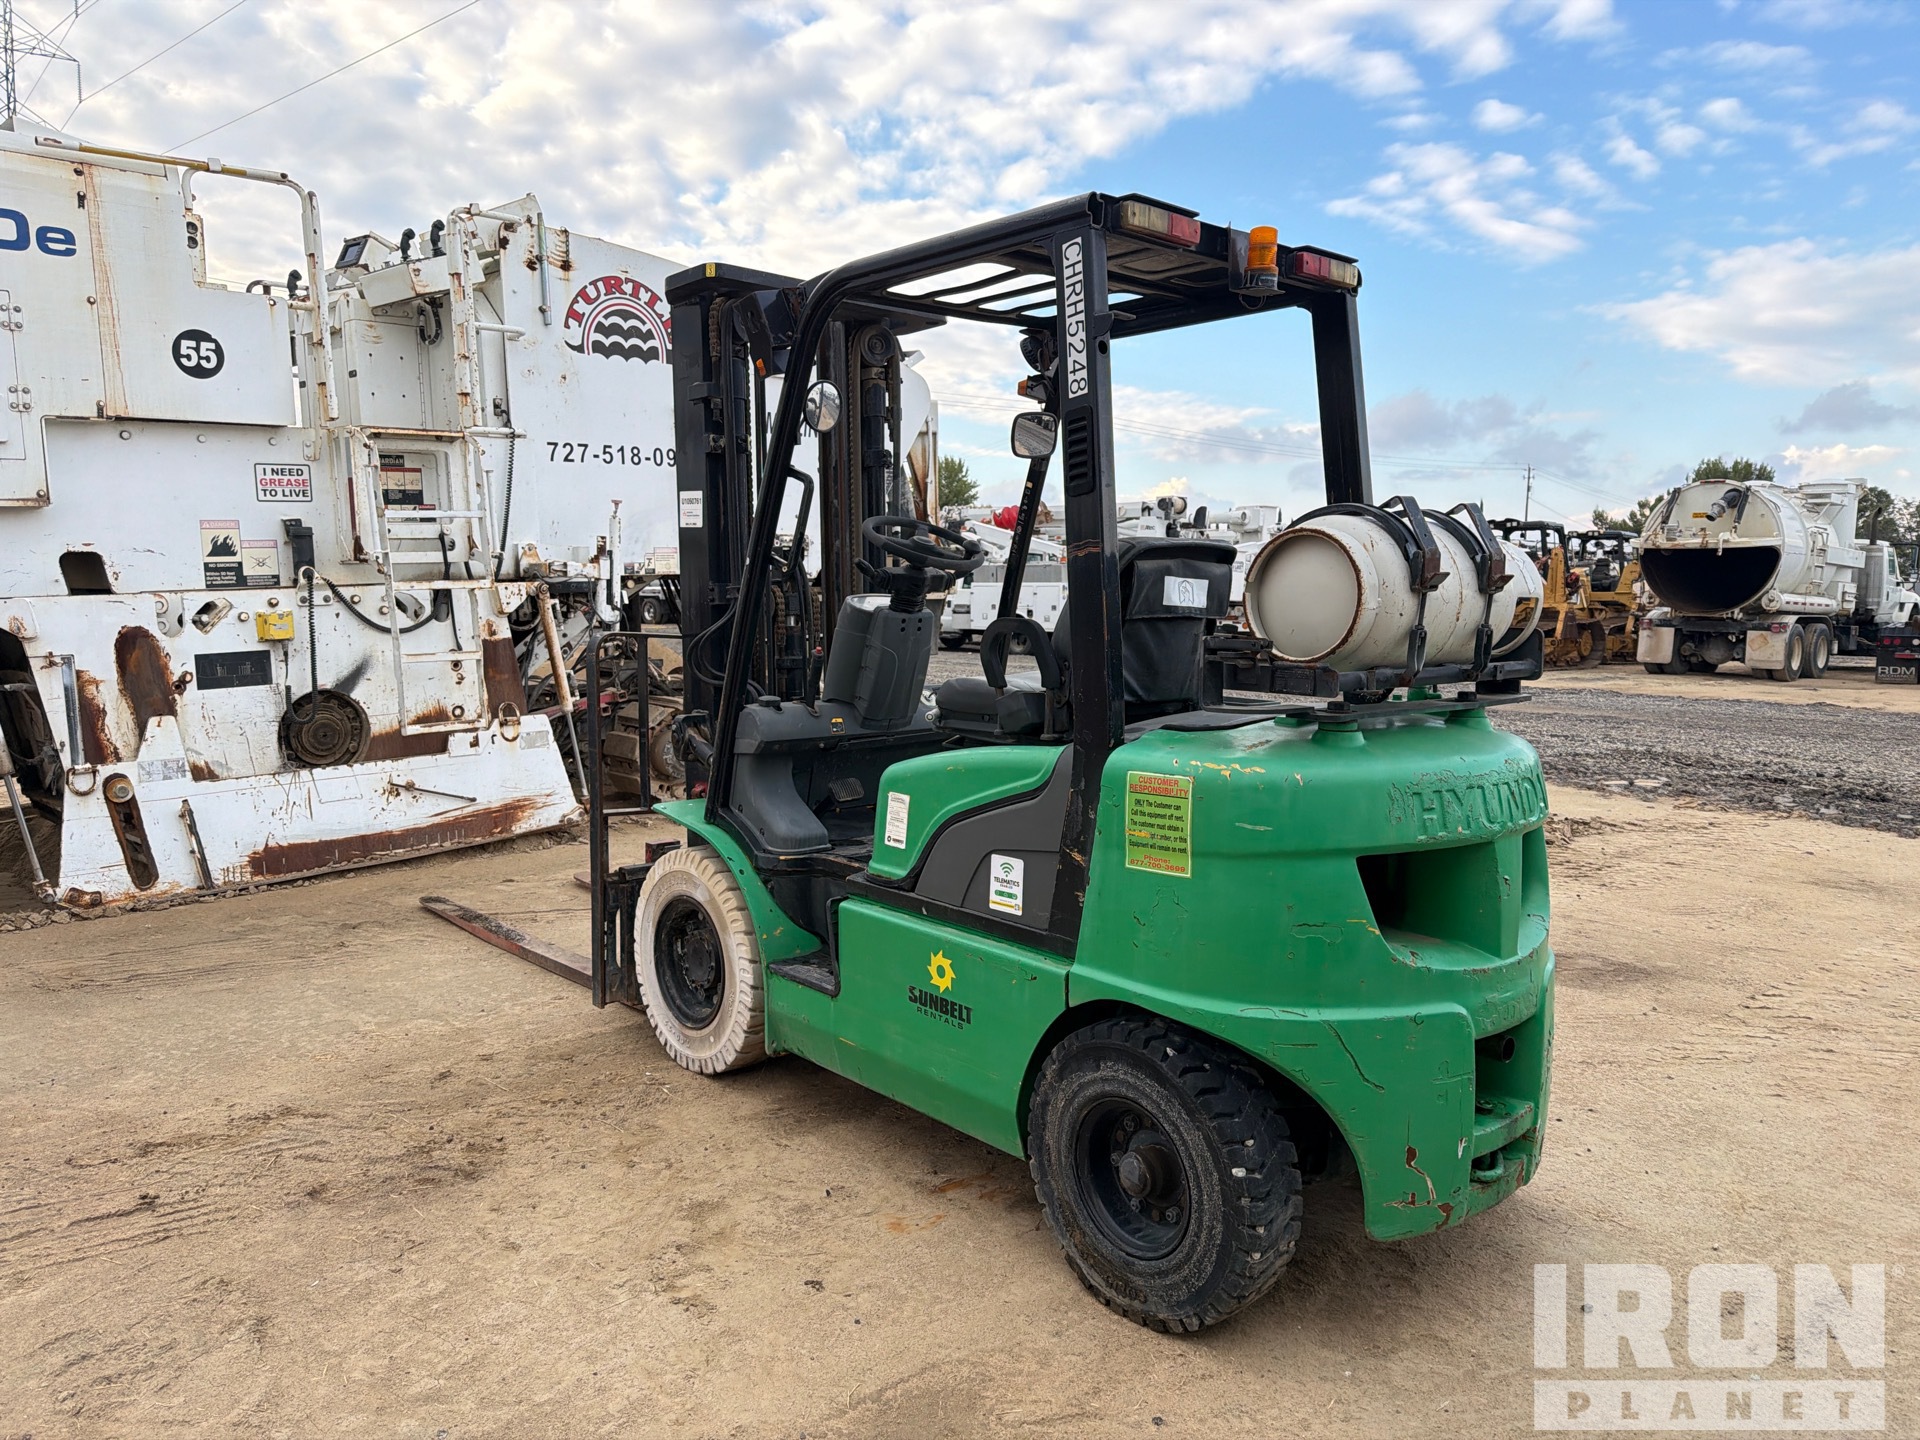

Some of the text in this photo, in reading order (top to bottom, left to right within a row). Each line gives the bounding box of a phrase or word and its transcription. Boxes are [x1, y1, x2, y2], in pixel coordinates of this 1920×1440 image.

[1063, 241, 1088, 395] CHRH5248
[179, 339, 218, 369] 55
[546, 441, 677, 467] 727-518-09
[380, 456, 404, 464] ARDIAN
[262, 467, 304, 477] I NEED
[259, 478, 310, 487] GREASE
[260, 488, 310, 498] TO LIVE
[1878, 666, 1916, 675] RDM
[1138, 776, 1180, 787] CUSTOMER
[1129, 783, 1189, 797] RESPONSIBILITY
[1134, 798, 1145, 807] ONLY
[1154, 801, 1173, 810] Customer
[1147, 811, 1167, 820] equipment
[1138, 820, 1156, 829] customer
[1156, 822, 1167, 830] must
[1167, 823, 1180, 832] obtain
[1129, 839, 1150, 849] Equipment
[1157, 843, 1171, 852] remain
[1179, 836, 1187, 844] this
[1143, 854, 1171, 864] Phone:
[993, 876, 1020, 887] TELEMATICS
[907, 985, 973, 1025] SUNBELT
[916, 1006, 964, 1030] RENTALS
